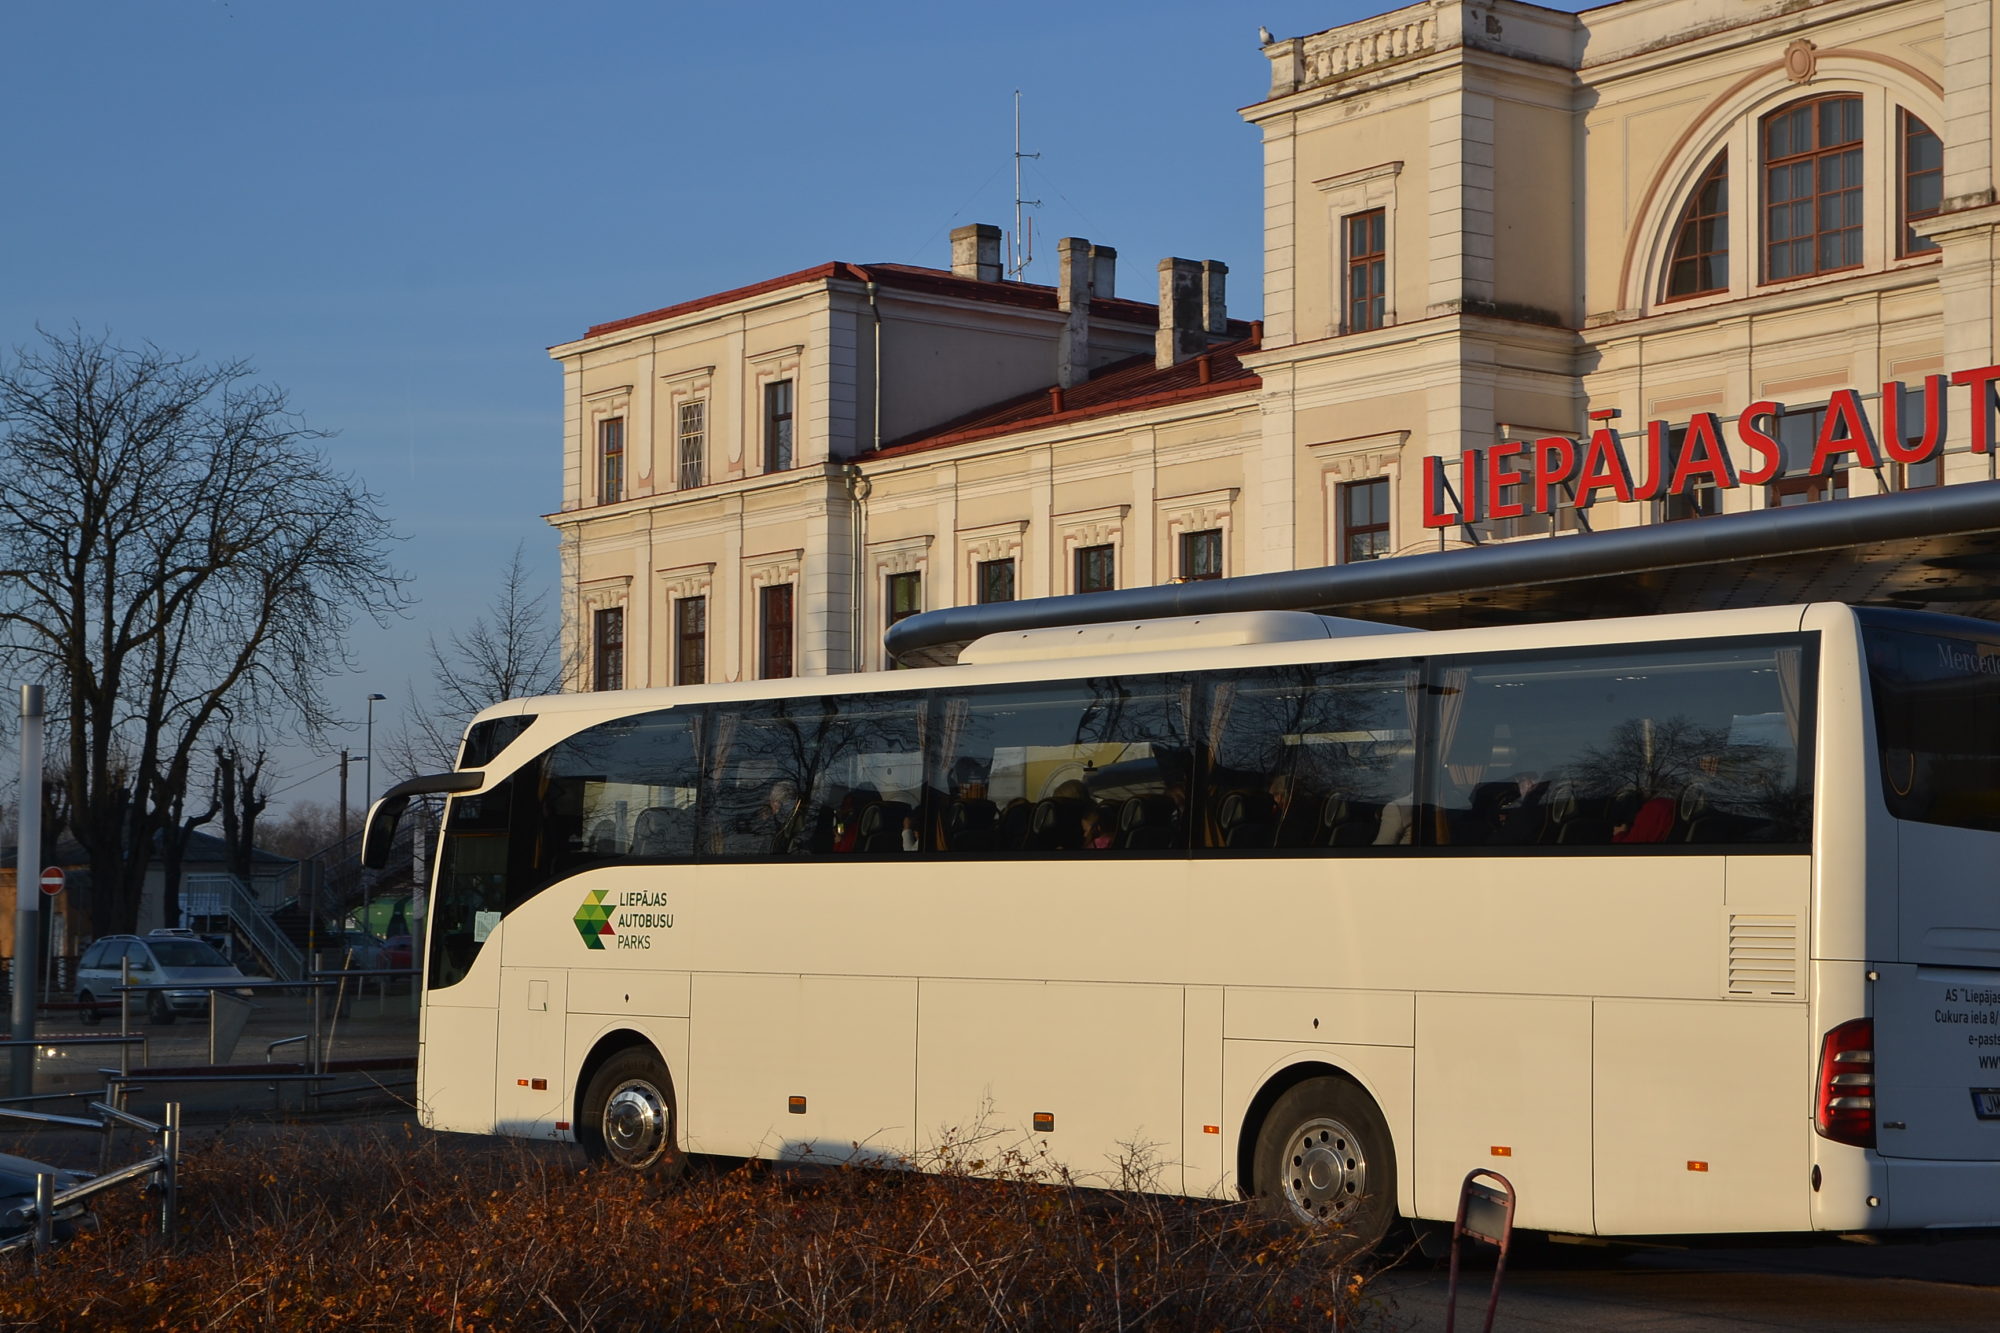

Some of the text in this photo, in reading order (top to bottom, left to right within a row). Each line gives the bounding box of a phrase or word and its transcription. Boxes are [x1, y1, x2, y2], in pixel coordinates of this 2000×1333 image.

[1423, 401, 1785, 528] LIEPĀJAS
[619, 890, 667, 906] LIEPĀJAS
[618, 914, 674, 928] AUTOBUSU
[618, 935, 651, 949] PARKS
[1945, 988, 1958, 1002] AS
[1935, 1010, 1968, 1024] Cukura
[1971, 1010, 1988, 1024] iela
[1979, 1056, 2000, 1069] WW
